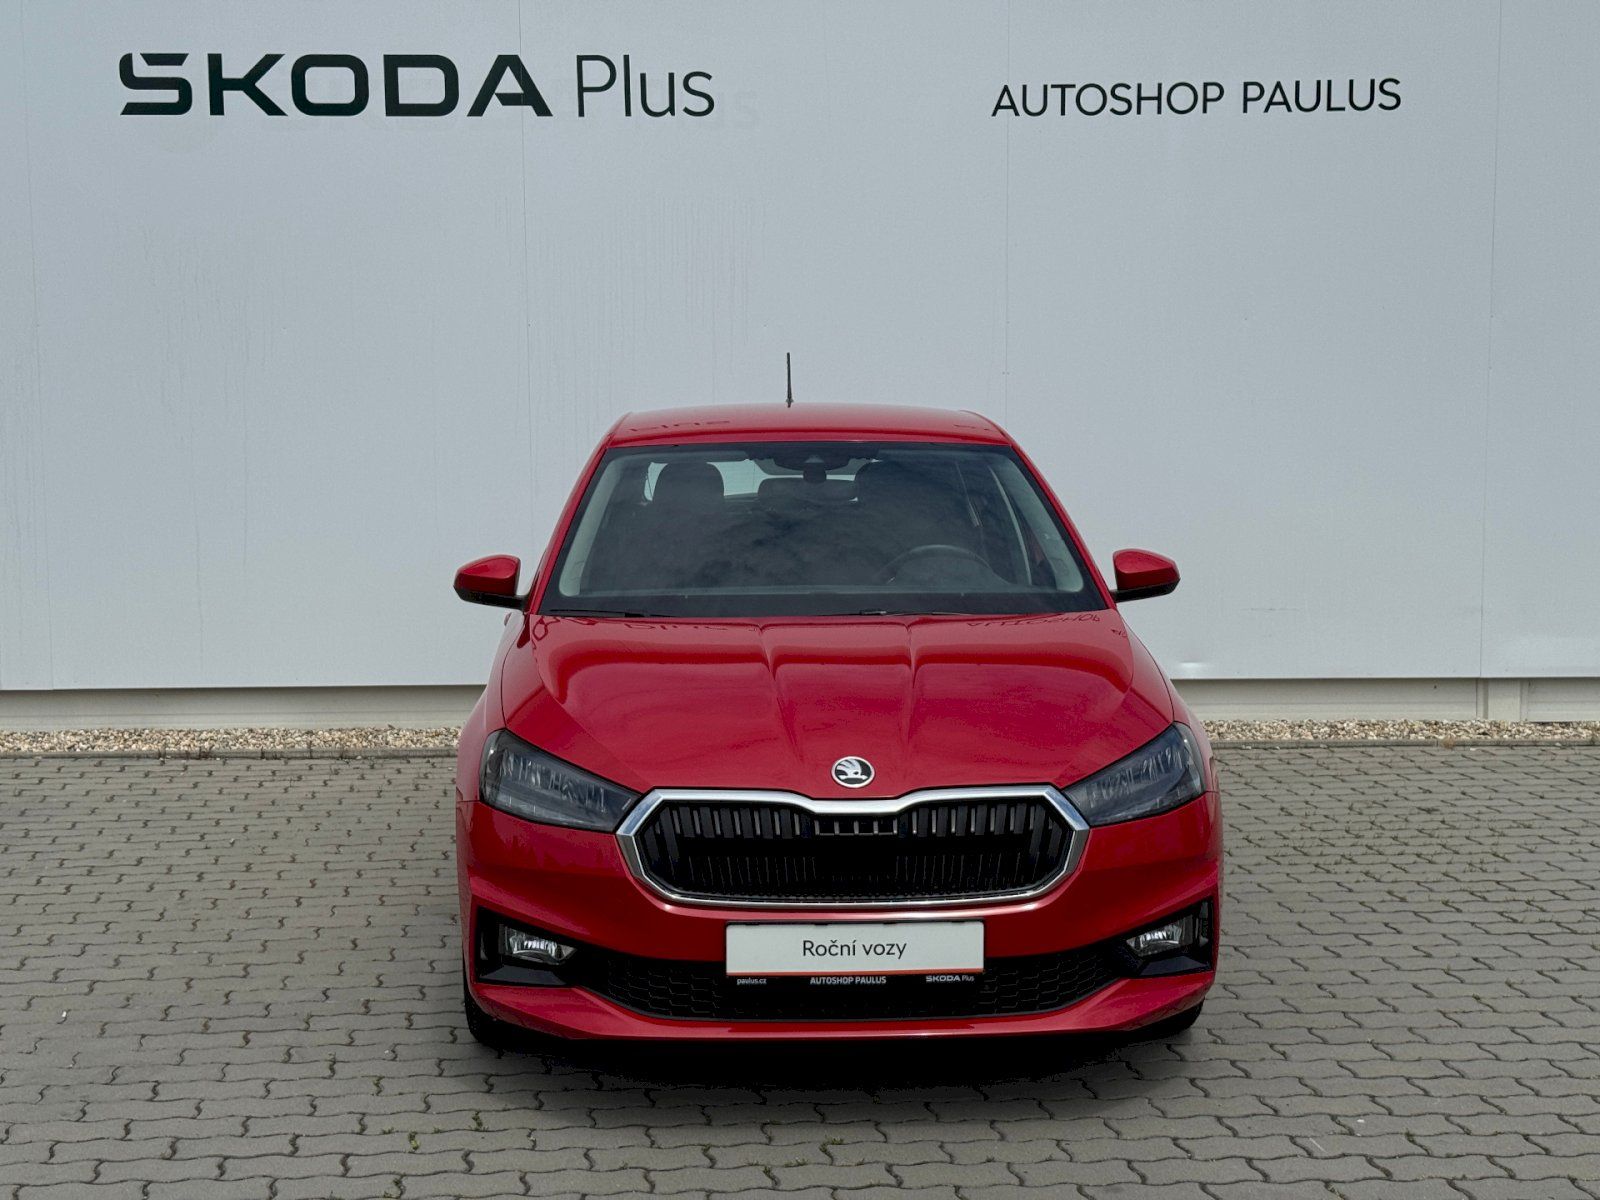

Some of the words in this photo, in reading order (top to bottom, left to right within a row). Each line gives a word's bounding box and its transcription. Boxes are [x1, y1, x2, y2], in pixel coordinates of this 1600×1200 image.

[576, 53, 715, 118] Plus
[991, 81, 1225, 117] AUTOSHOP
[1242, 78, 1402, 114] PAULUS
[802, 939, 857, 957] Roční
[862, 943, 908, 960] vozy
[736, 978, 767, 986] paulus.cz
[810, 977, 854, 985] AUTOSHOP
[855, 976, 887, 984] PAULUS
